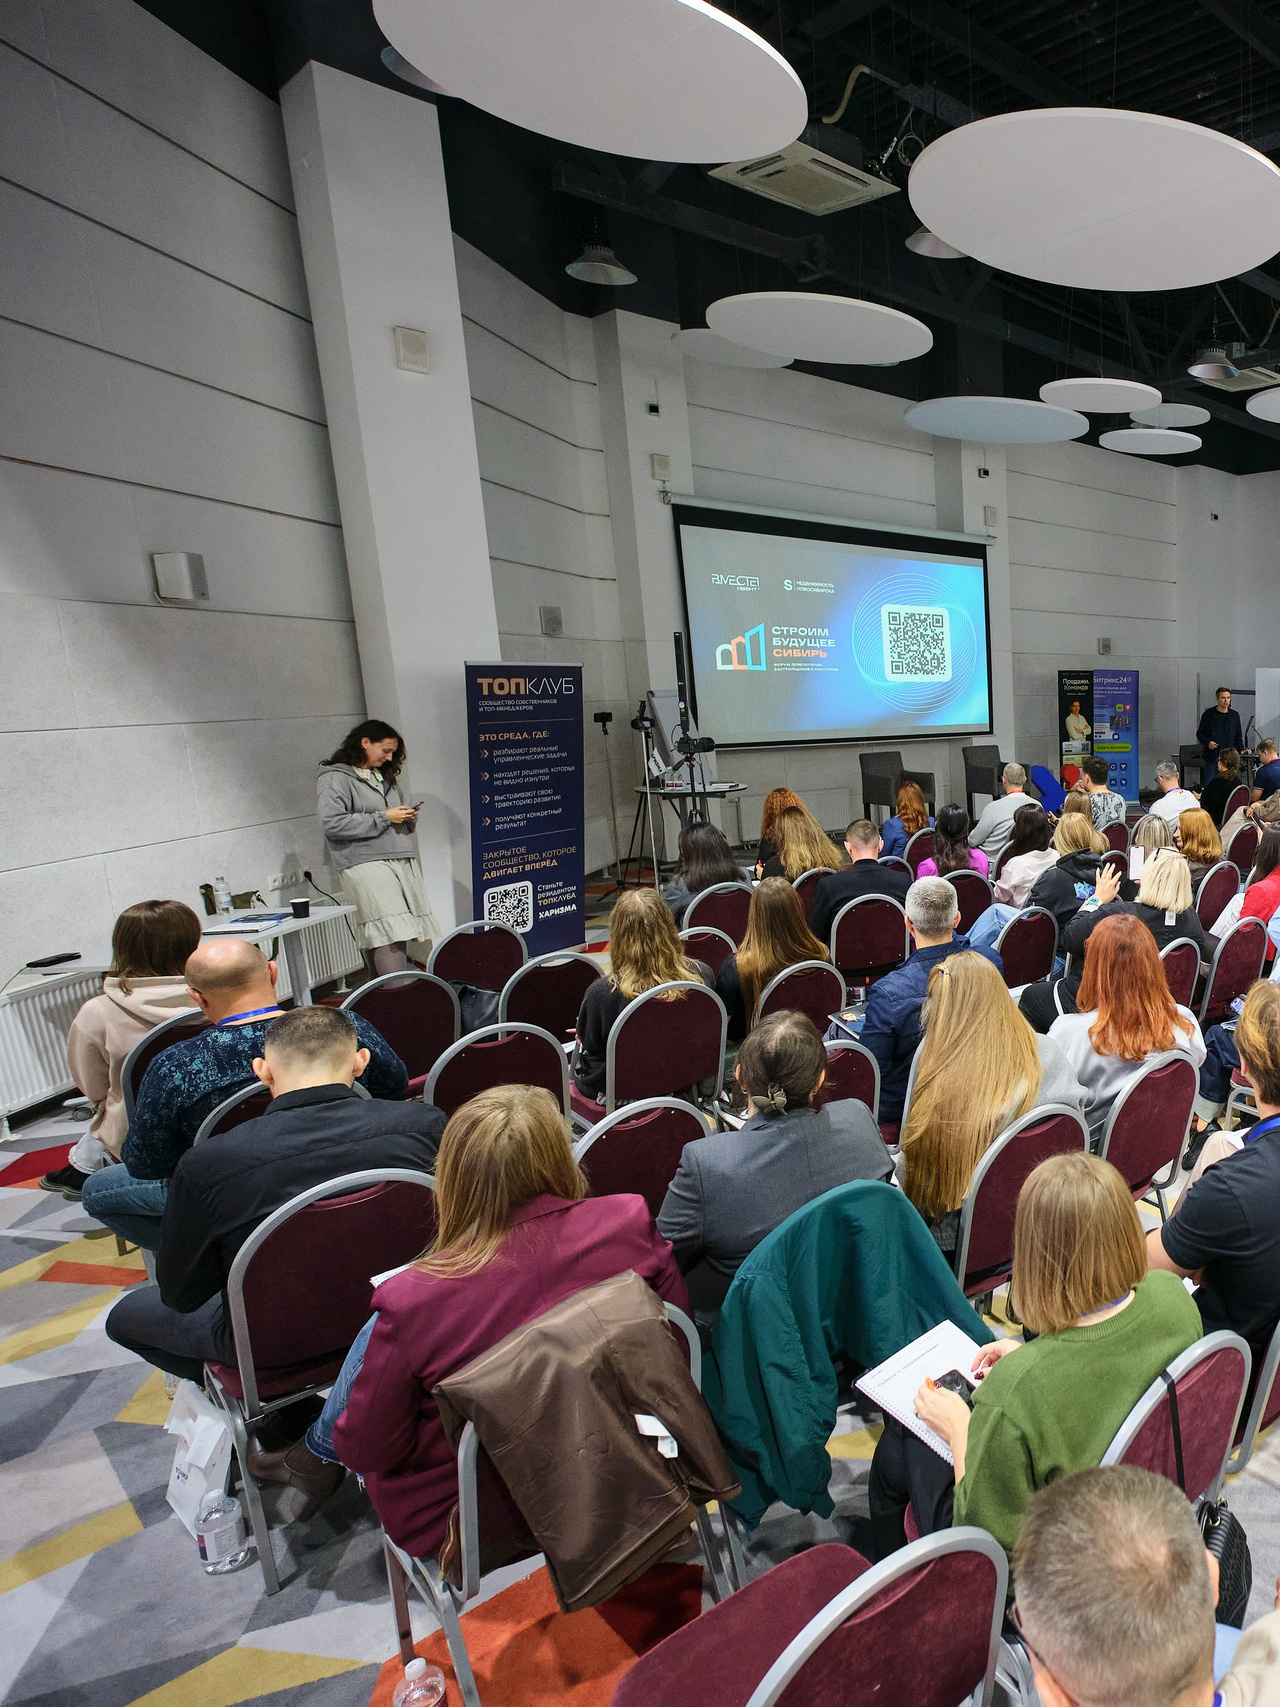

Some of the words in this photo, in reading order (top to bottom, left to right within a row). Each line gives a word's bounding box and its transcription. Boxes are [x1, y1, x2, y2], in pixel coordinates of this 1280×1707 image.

[784, 580, 792, 590] S
[772, 626, 828, 636] СТРОИМ
[772, 638, 836, 648] БУДУЩЕЕ
[773, 649, 828, 658] СИБИРЬ
[477, 677, 574, 695] ТОПКЛУБ
[498, 732, 530, 740] СРЕДА,
[493, 748, 528, 756] разбирают
[530, 746, 558, 754] реальные
[494, 753, 545, 763] управленческие
[494, 770, 520, 778] находят
[522, 768, 550, 776] решения,
[494, 791, 536, 801] выстраивают
[495, 799, 532, 808] траекторию
[534, 795, 561, 804] развития
[495, 814, 526, 822] получают
[527, 808, 562, 818] конкретный
[495, 821, 526, 831] результат
[483, 846, 526, 860] ЗАКРЫТОЕ
[483, 853, 541, 869] СООБЩЕСТВО,
[543, 846, 577, 858] КОТОРОЕ
[483, 866, 523, 880] ДВИГАЕТ
[525, 859, 557, 871] ВПЕРЁД
[537, 882, 563, 891] Станьте
[537, 886, 576, 899] резидентом
[538, 892, 576, 906] ТОПКЛУБА
[539, 904, 577, 918] ХАРИЗМА
